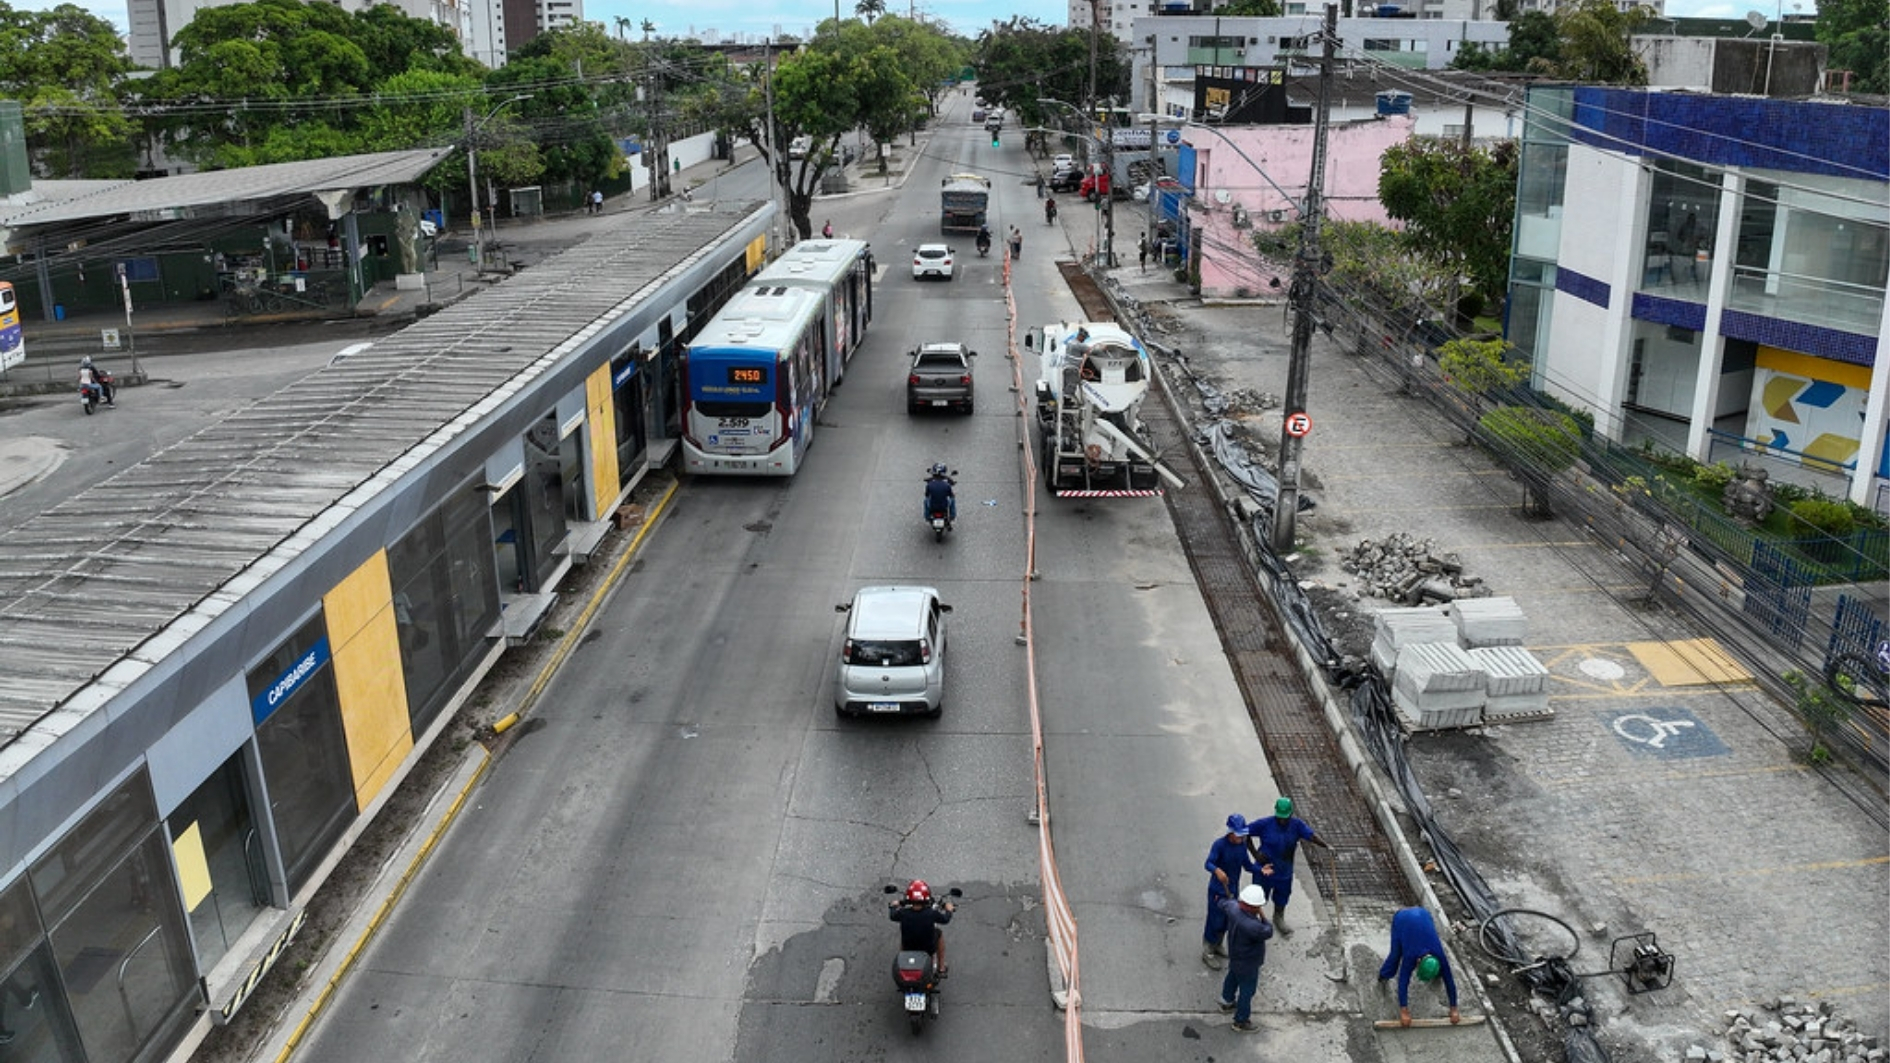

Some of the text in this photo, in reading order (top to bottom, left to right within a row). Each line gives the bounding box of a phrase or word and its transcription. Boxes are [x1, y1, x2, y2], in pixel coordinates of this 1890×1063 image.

[734, 370, 760, 381] 2450
[718, 417, 749, 428] 2.519
[268, 651, 316, 705] CAPIBARIBE
